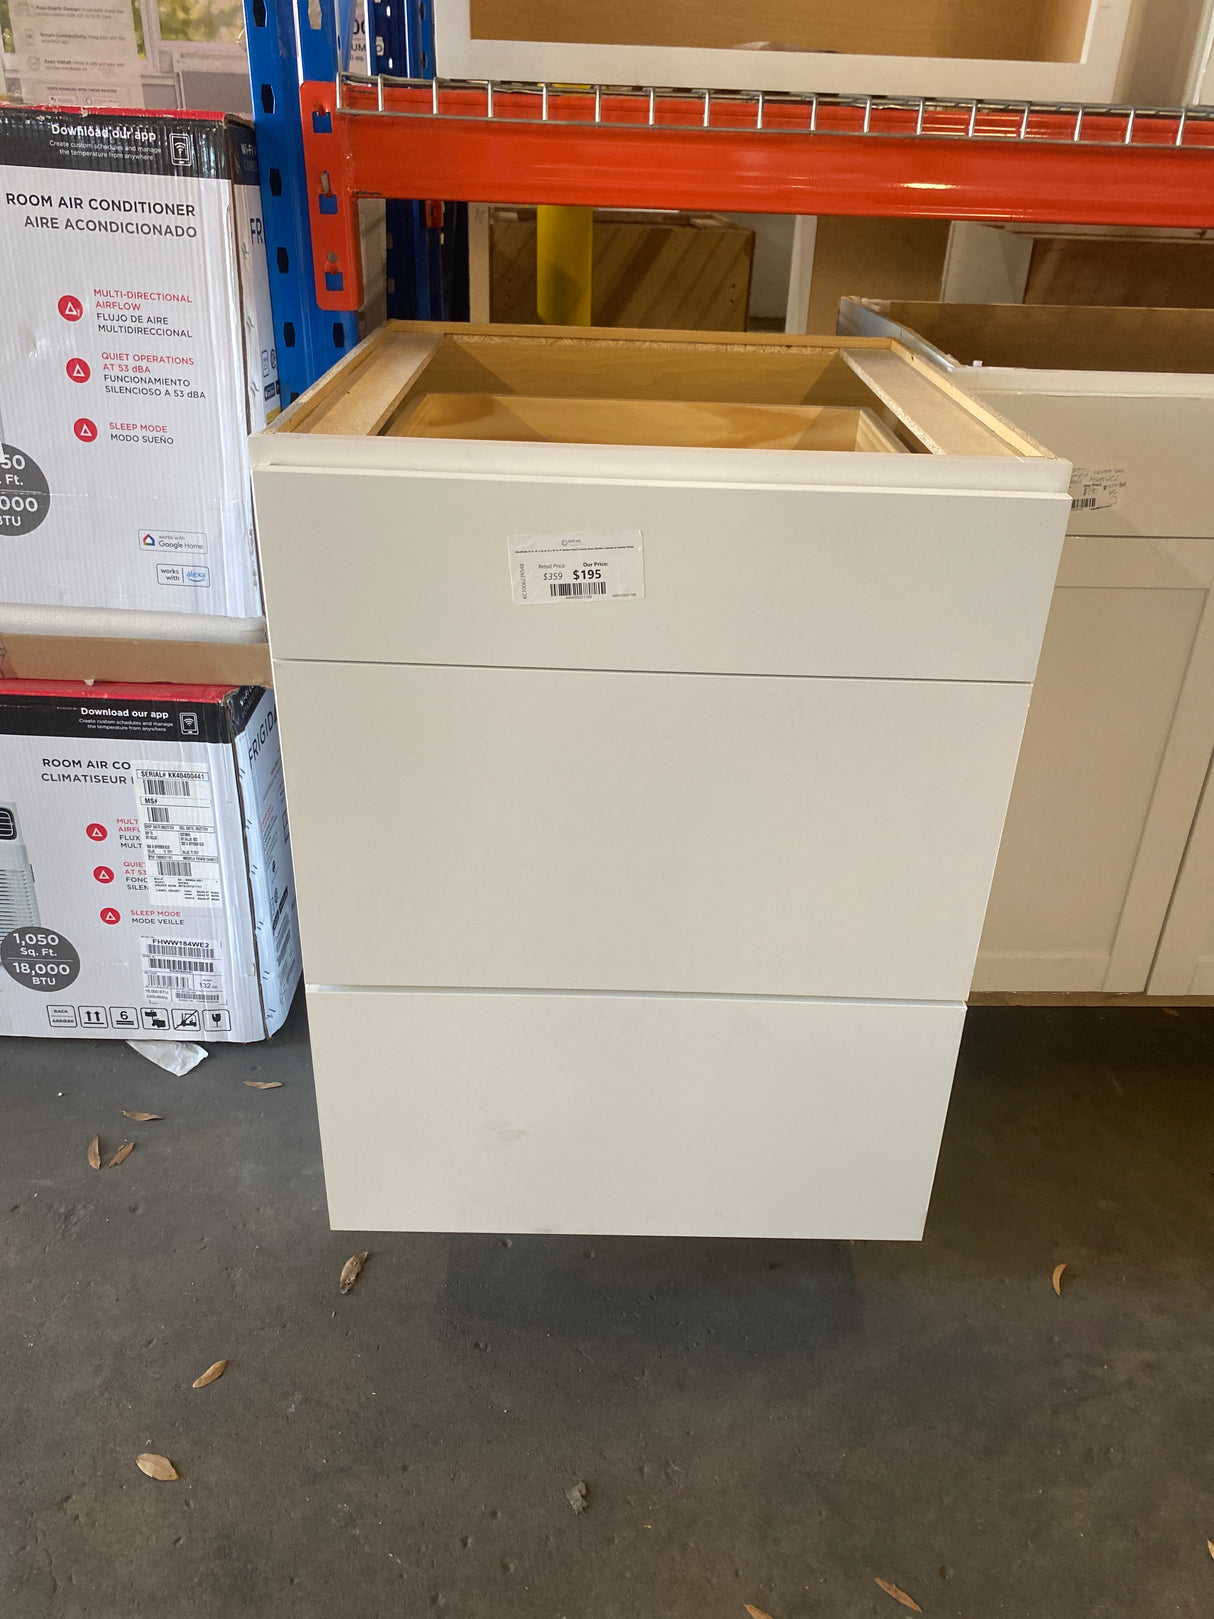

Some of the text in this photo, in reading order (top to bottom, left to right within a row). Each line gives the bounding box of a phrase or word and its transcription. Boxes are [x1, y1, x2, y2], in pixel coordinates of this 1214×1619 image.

[51, 124, 156, 143] Download our app
[70, 141, 93, 149] custom
[71, 150, 108, 159] temperature
[124, 153, 154, 162] anywhere
[6, 193, 196, 217] ROOM AIR CONDITIONER
[24, 216, 197, 238] AIRE ACONDICIONADO
[94, 289, 192, 303] MULTI-DIRECTIONAL
[96, 301, 141, 311] AIRFLOW
[96, 313, 168, 325] FLUJO DE AIRE
[98, 324, 192, 338] MULTIDIRECCIONAL
[102, 352, 194, 365] QUIET OPERATIONS
[103, 363, 115, 371] AT
[118, 364, 129, 372] 53
[104, 374, 190, 387] FUNCIONAMIENTO
[105, 386, 206, 399] SILENCIOSO A 53 dBA
[109, 422, 167, 433] SLEEP MODE
[110, 434, 174, 444] MODO SUEÑO
[6, 474, 23, 485] Ft.
[0, 515, 21, 526] TU
[159, 540, 183, 549] Google
[187, 570, 206, 578] alexa
[543, 572, 562, 581] $359
[573, 569, 601, 580] $195
[80, 707, 129, 717] Download
[151, 712, 169, 720] app
[42, 758, 82, 768] ROOM
[86, 760, 108, 769] AIR
[41, 773, 127, 784] CLIMATISEUR
[13, 933, 59, 946] 1,050
[152, 939, 209, 948] FHWW184WE2
[20, 948, 38, 956] Sq.
[13, 962, 70, 975] 18,000
[32, 977, 56, 985] BTU
[120, 1011, 128, 1020] 6
